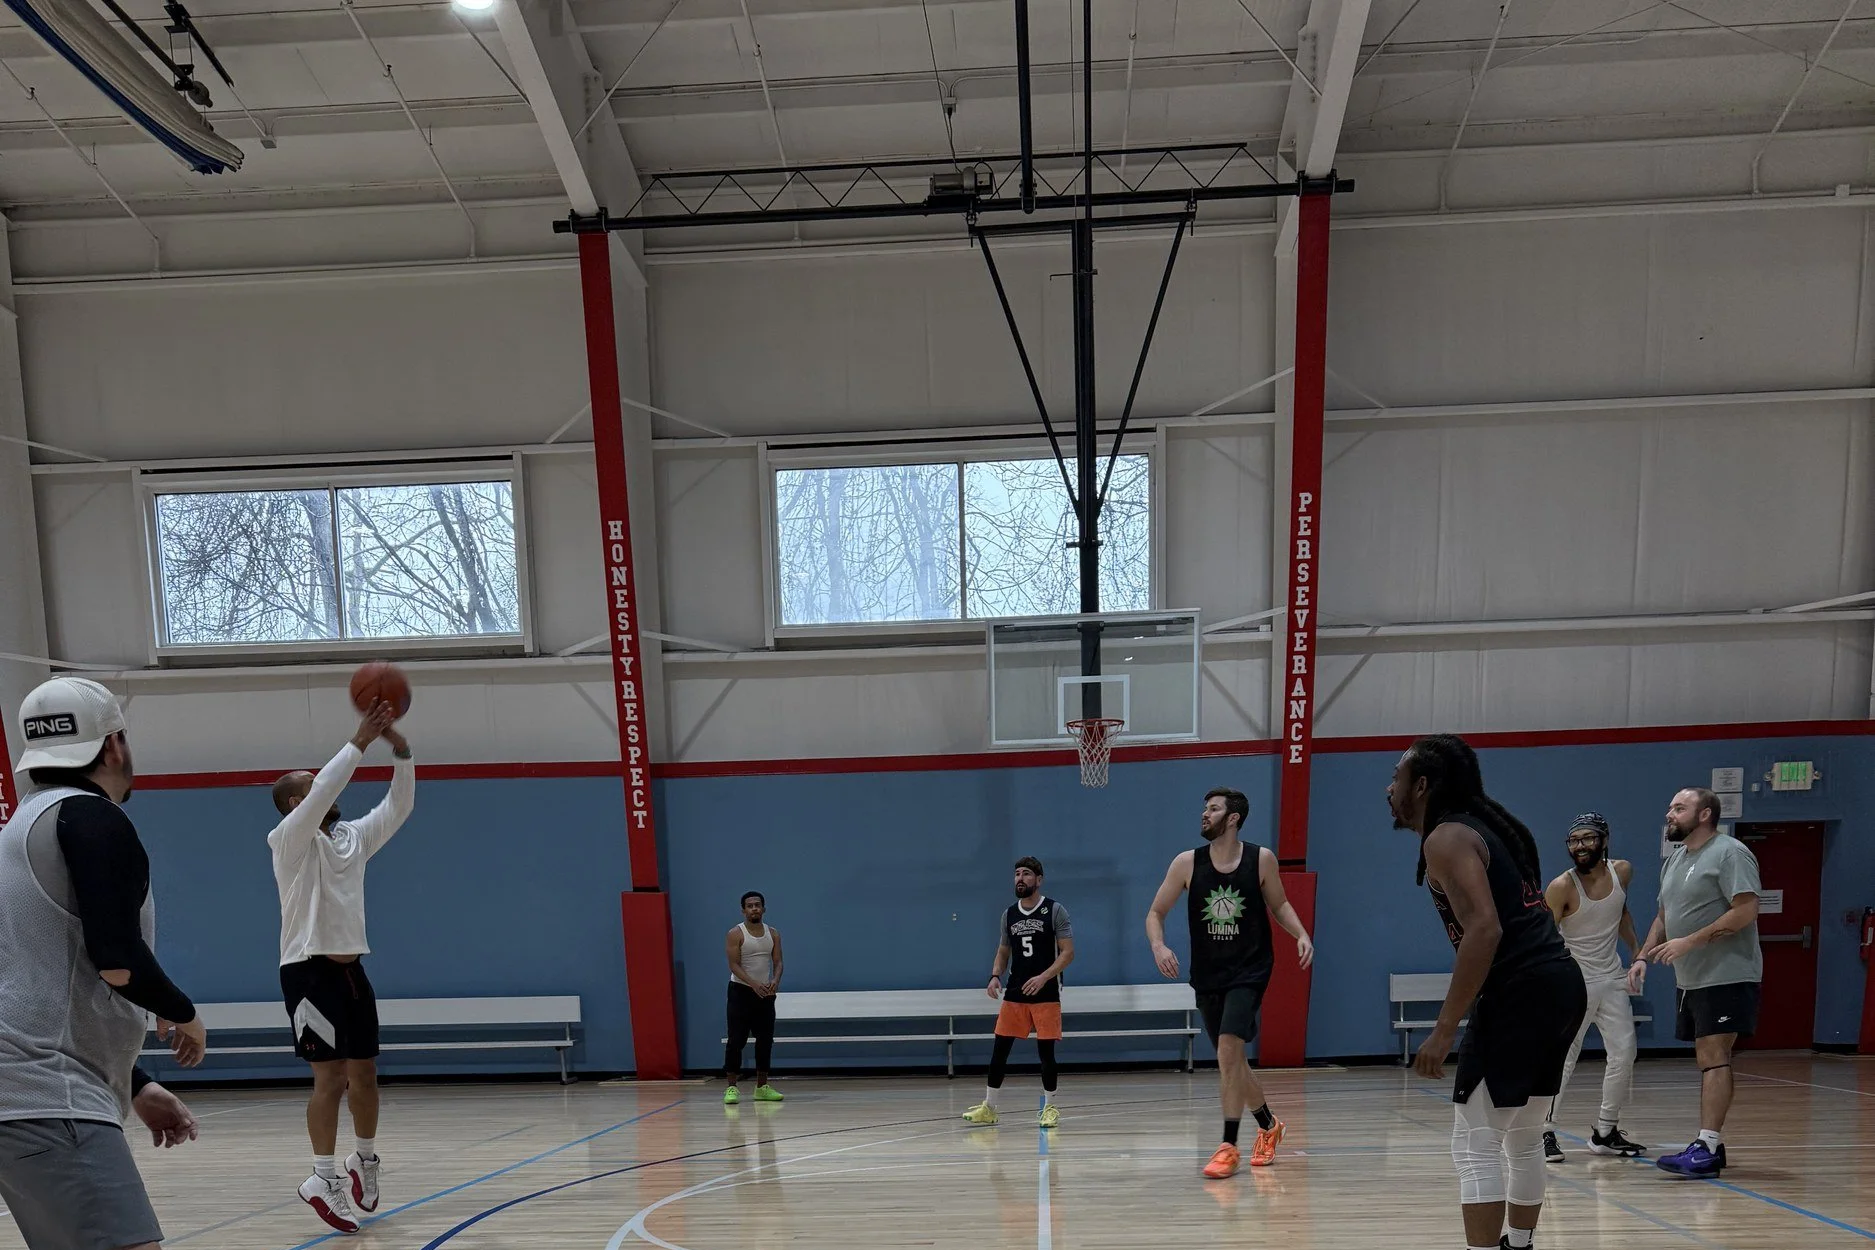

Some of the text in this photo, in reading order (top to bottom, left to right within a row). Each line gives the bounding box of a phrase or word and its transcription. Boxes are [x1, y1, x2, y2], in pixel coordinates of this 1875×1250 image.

[1289, 492, 1312, 763] PERSEVERANCE
[608, 520, 647, 828] HONESTY RESPECT
[26, 717, 72, 737] PING
[1207, 923, 1240, 935] LUMINA
[1021, 936, 1033, 957] 5
